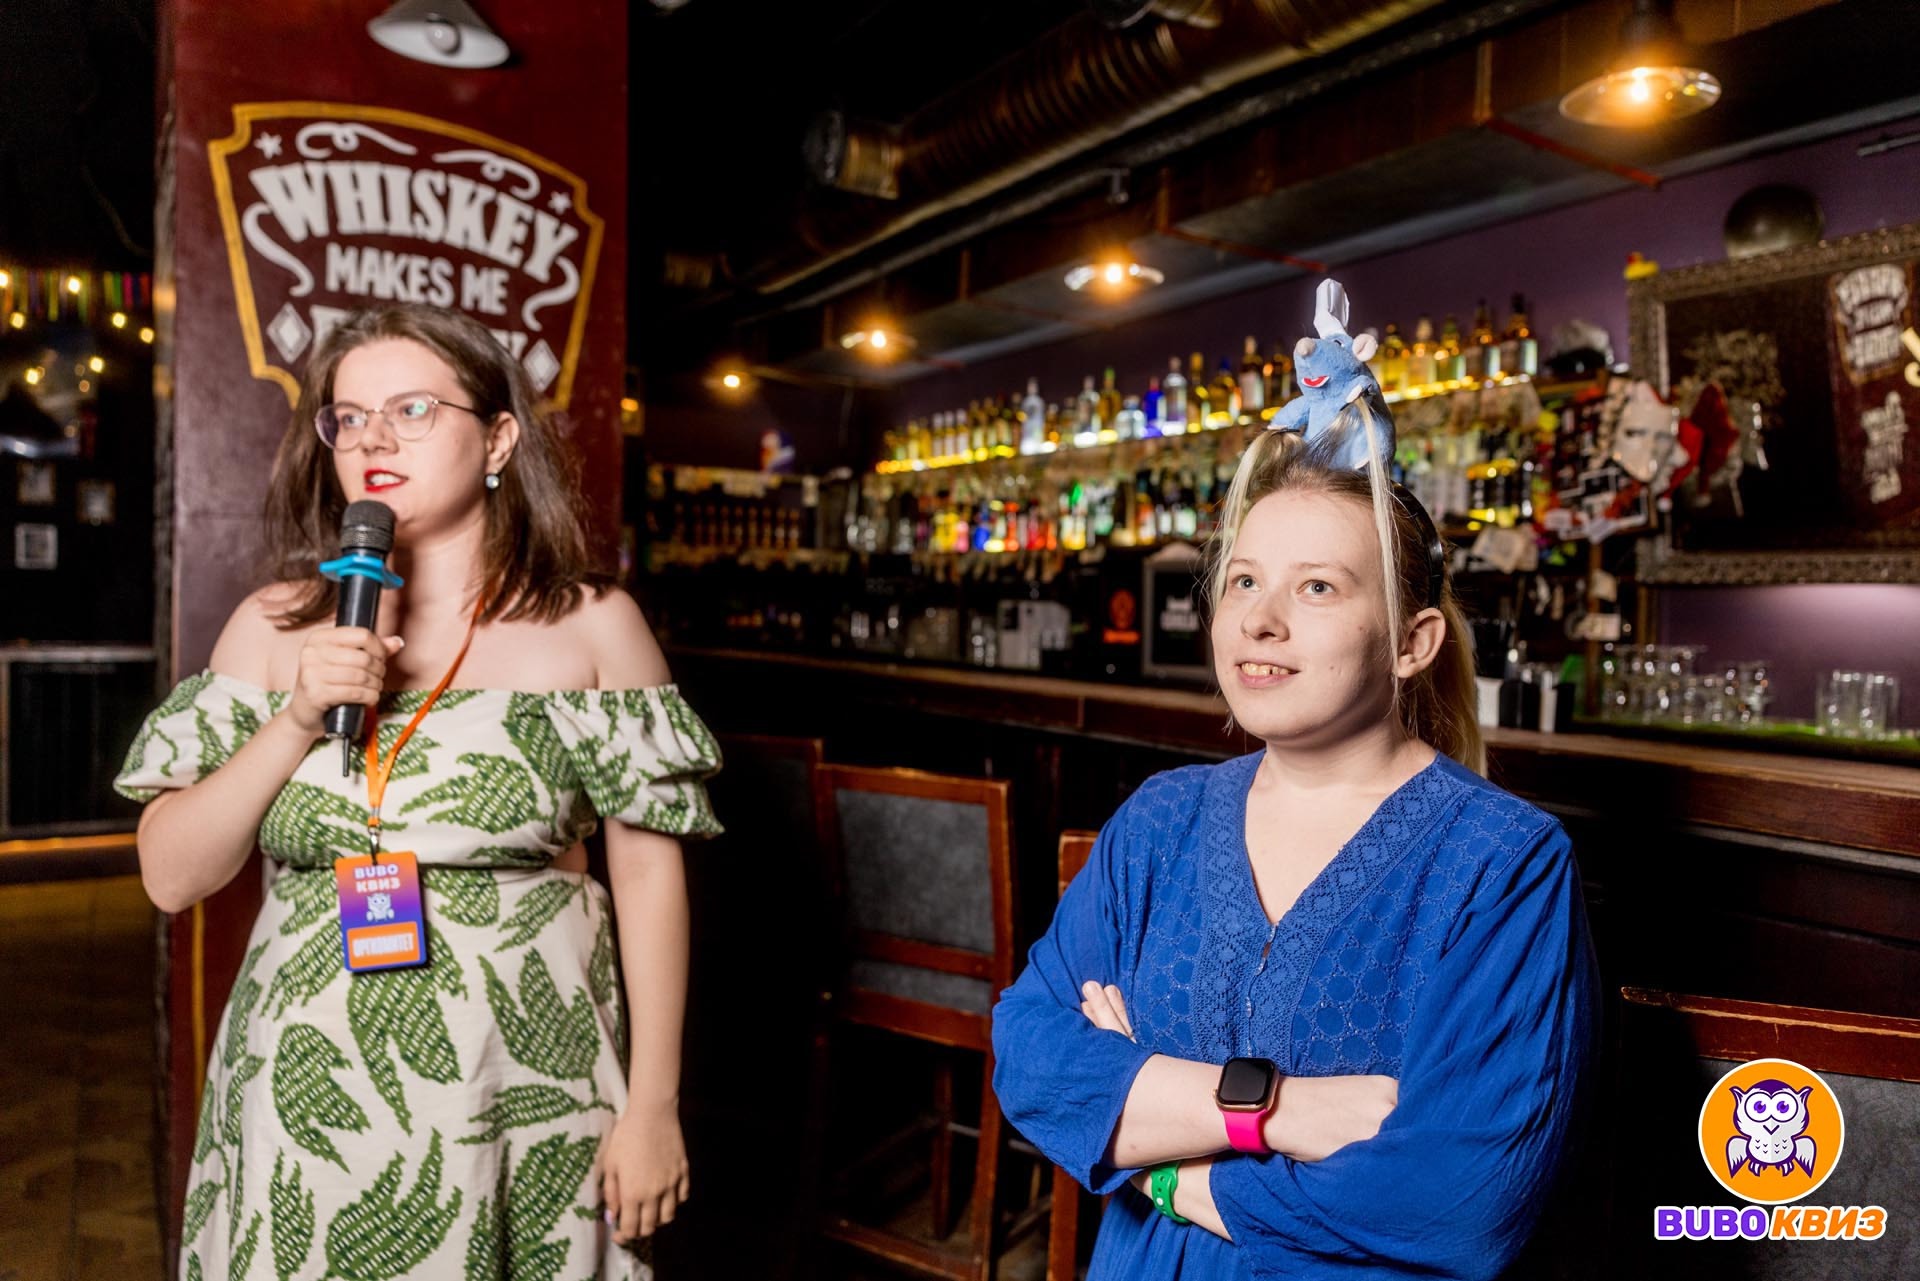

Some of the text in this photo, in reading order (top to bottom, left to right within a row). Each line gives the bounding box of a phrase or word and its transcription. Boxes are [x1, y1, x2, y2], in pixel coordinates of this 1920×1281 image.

[248, 160, 579, 283] WHISKEY
[325, 242, 509, 315] MAKES ME
[353, 863, 399, 880] BUBO
[355, 876, 401, 893] КВИЗ
